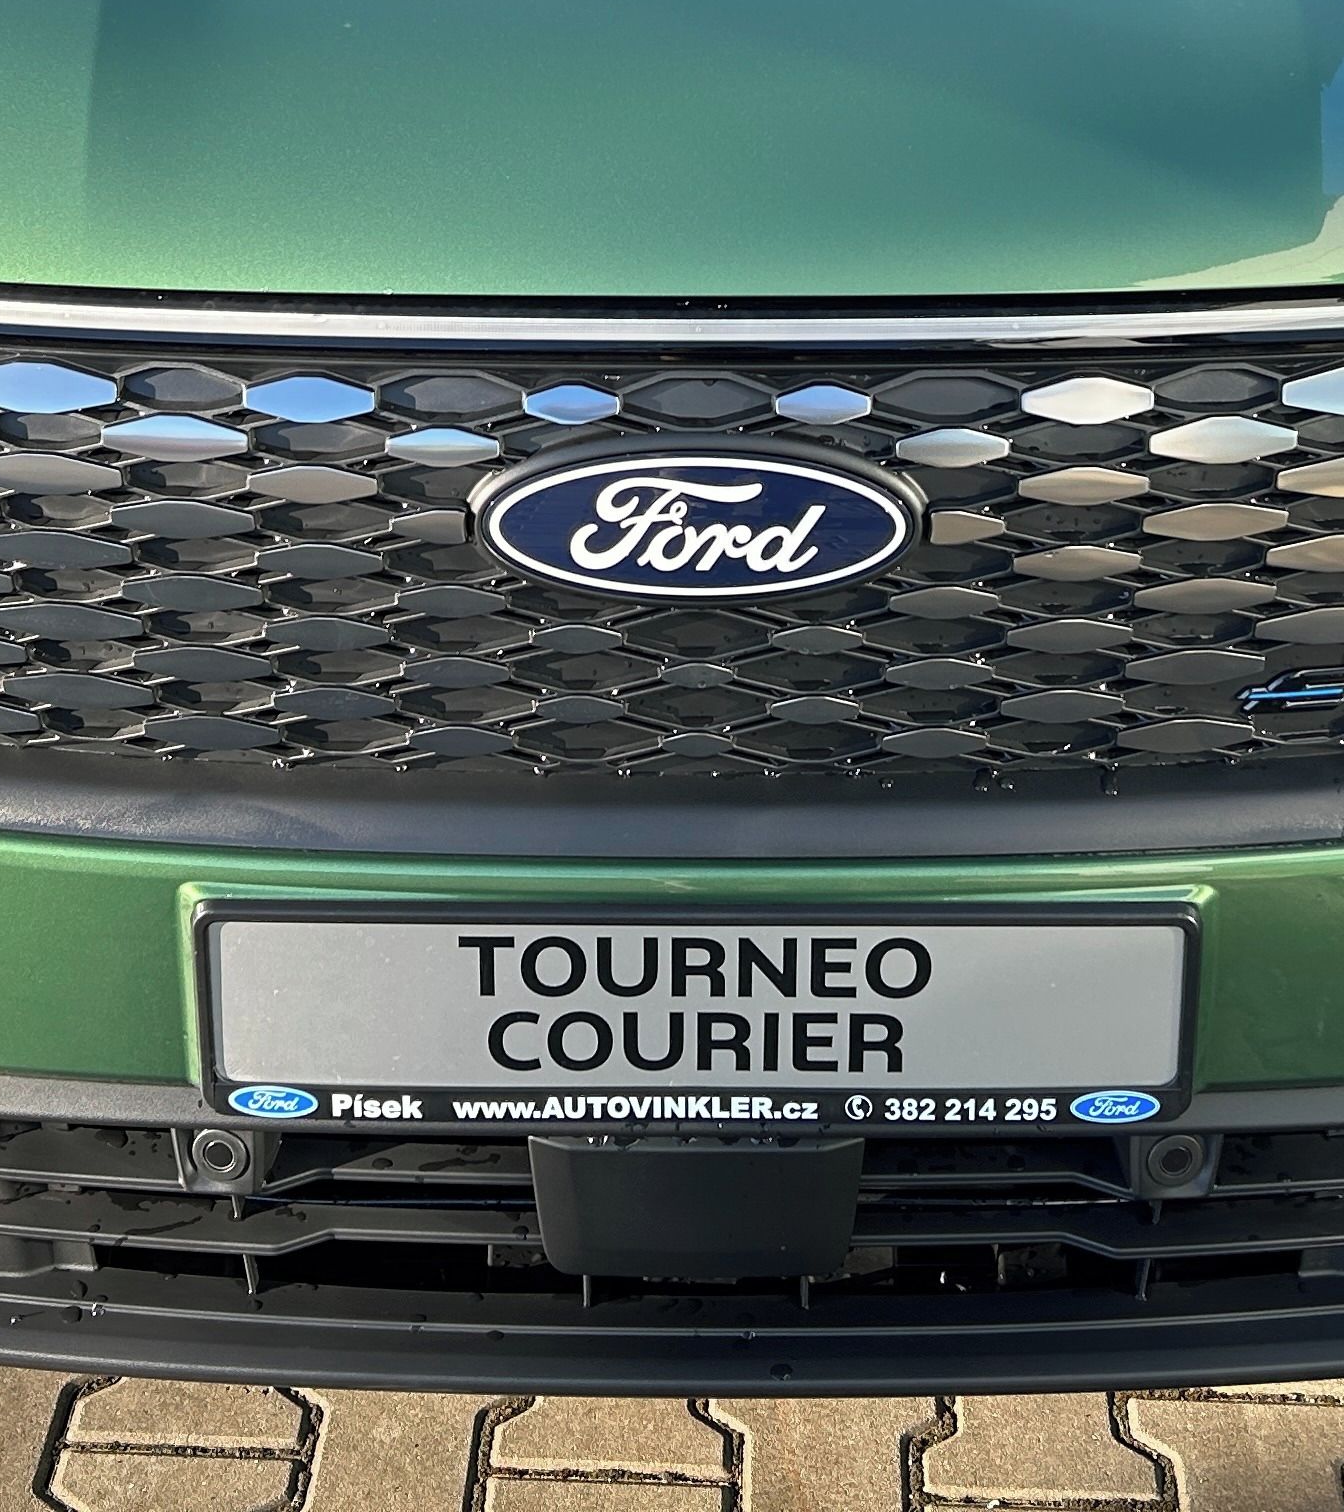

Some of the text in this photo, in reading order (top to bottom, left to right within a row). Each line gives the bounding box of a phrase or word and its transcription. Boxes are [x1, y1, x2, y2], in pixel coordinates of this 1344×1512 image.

[569, 476, 826, 574] Ford
[457, 935, 933, 999] TOURNEO
[487, 1010, 905, 1074] COURIER
[331, 1093, 423, 1119] Písek
[452, 1095, 819, 1120] www.AUTOVINKLER.cz
[884, 1097, 936, 1121] 382
[944, 1097, 997, 1121] 214
[1005, 1097, 1057, 1121] 295
